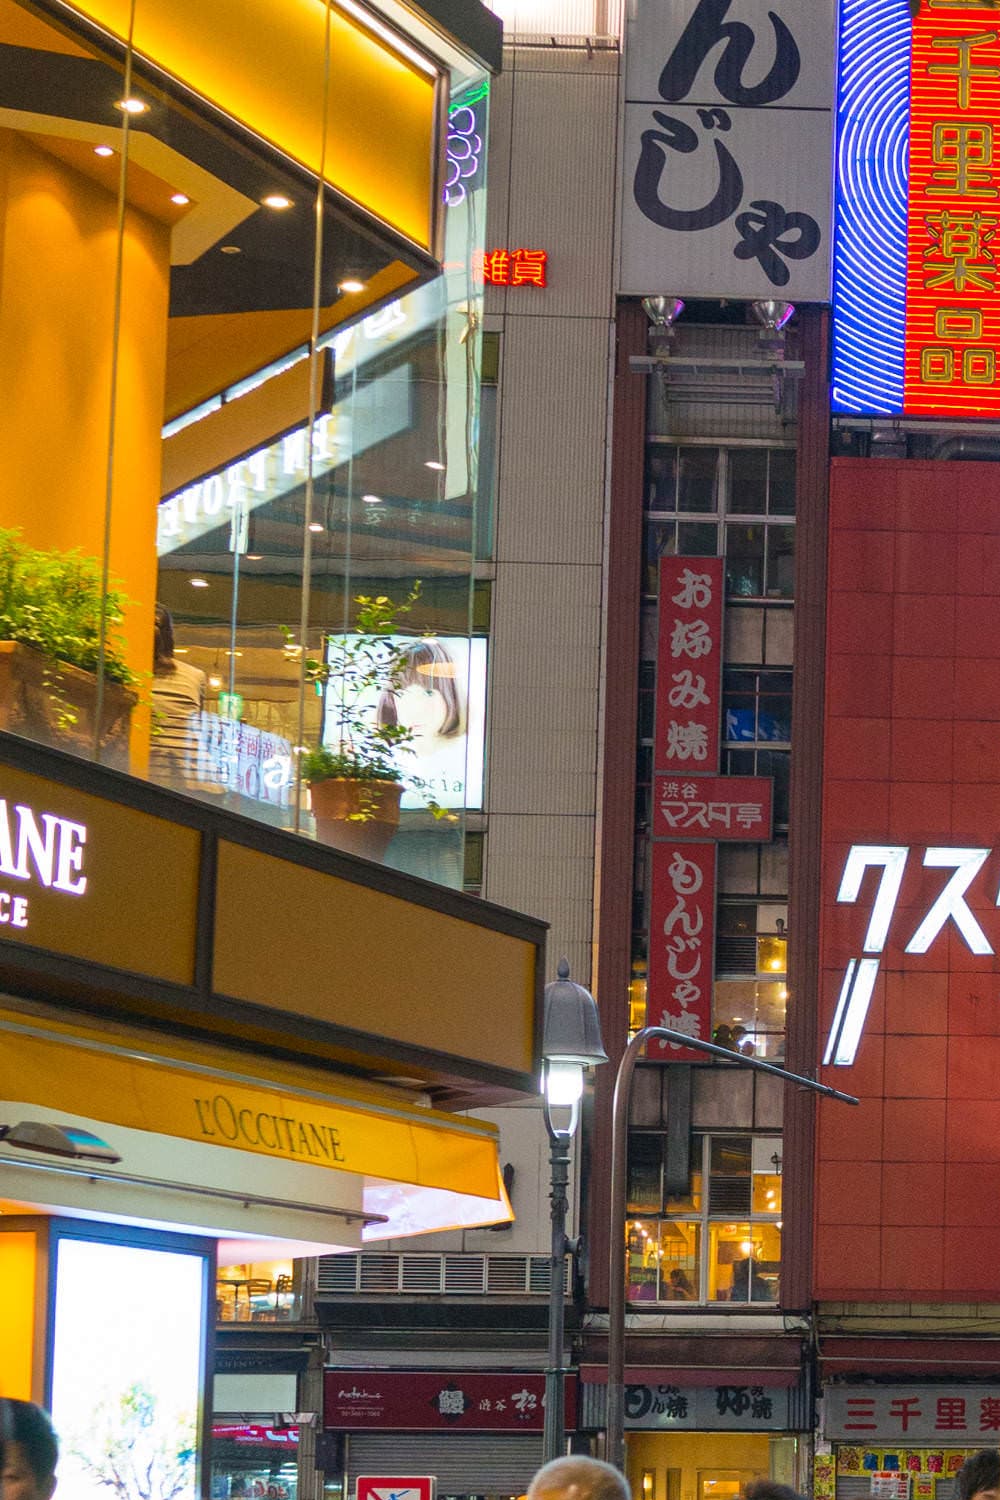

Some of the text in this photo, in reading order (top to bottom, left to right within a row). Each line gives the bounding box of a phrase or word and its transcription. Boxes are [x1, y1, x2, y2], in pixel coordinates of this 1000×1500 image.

[920, 0, 1000, 384] 千里薬品
[665, 568, 713, 761] お好み焼
[662, 783, 698, 799] 渋谷
[195, 1094, 346, 1163] L'OCCITANE
[511, 1389, 546, 1412] 松
